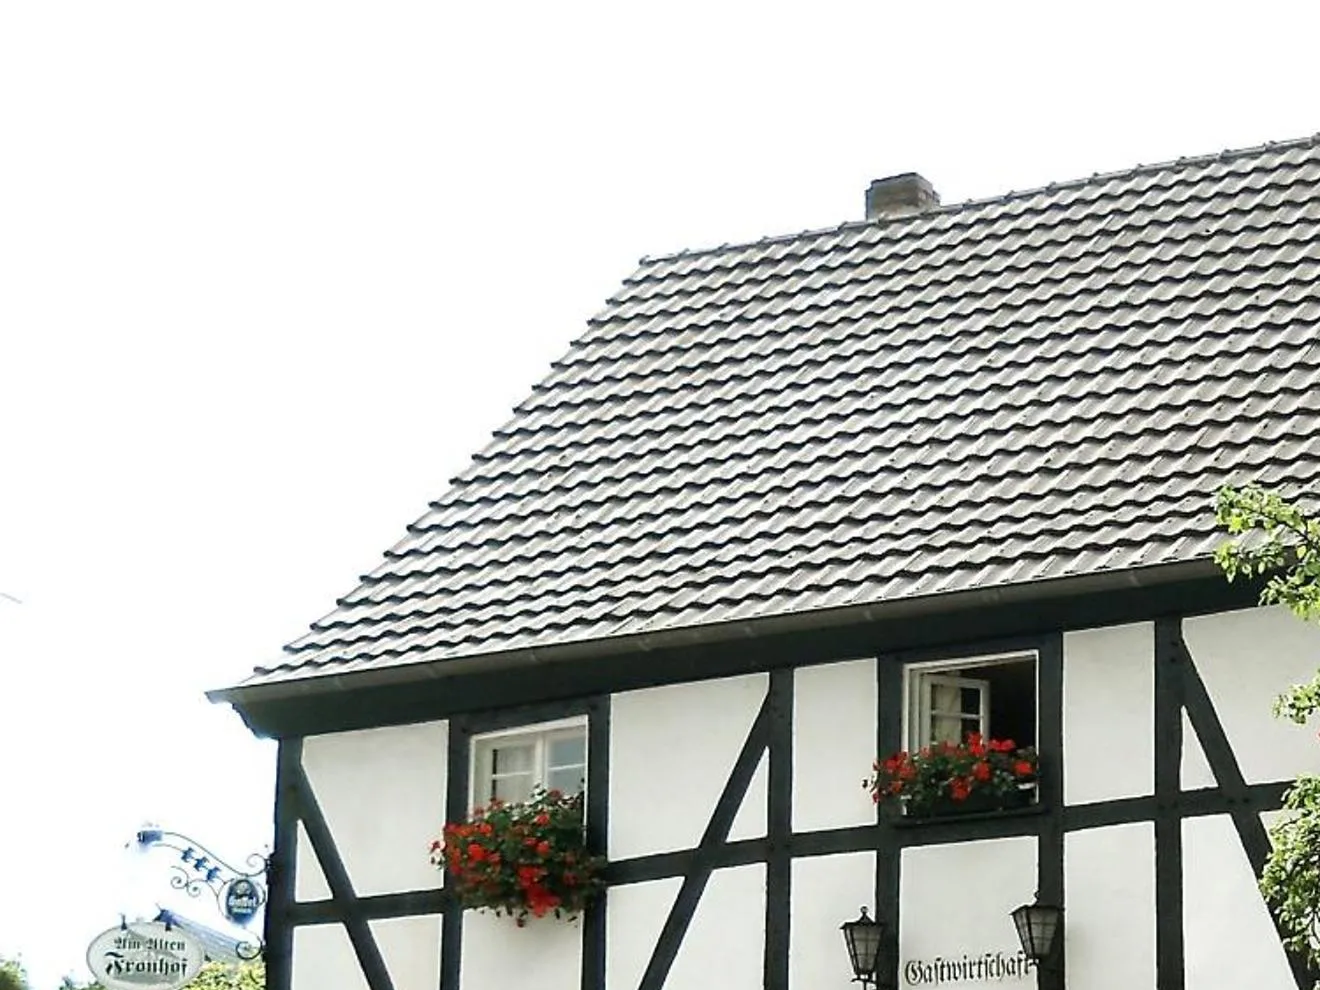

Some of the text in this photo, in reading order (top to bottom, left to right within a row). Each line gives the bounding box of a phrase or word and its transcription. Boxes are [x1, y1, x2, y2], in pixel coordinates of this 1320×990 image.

[114, 938, 186, 952] Am Alten
[104, 953, 188, 976] Fronhof
